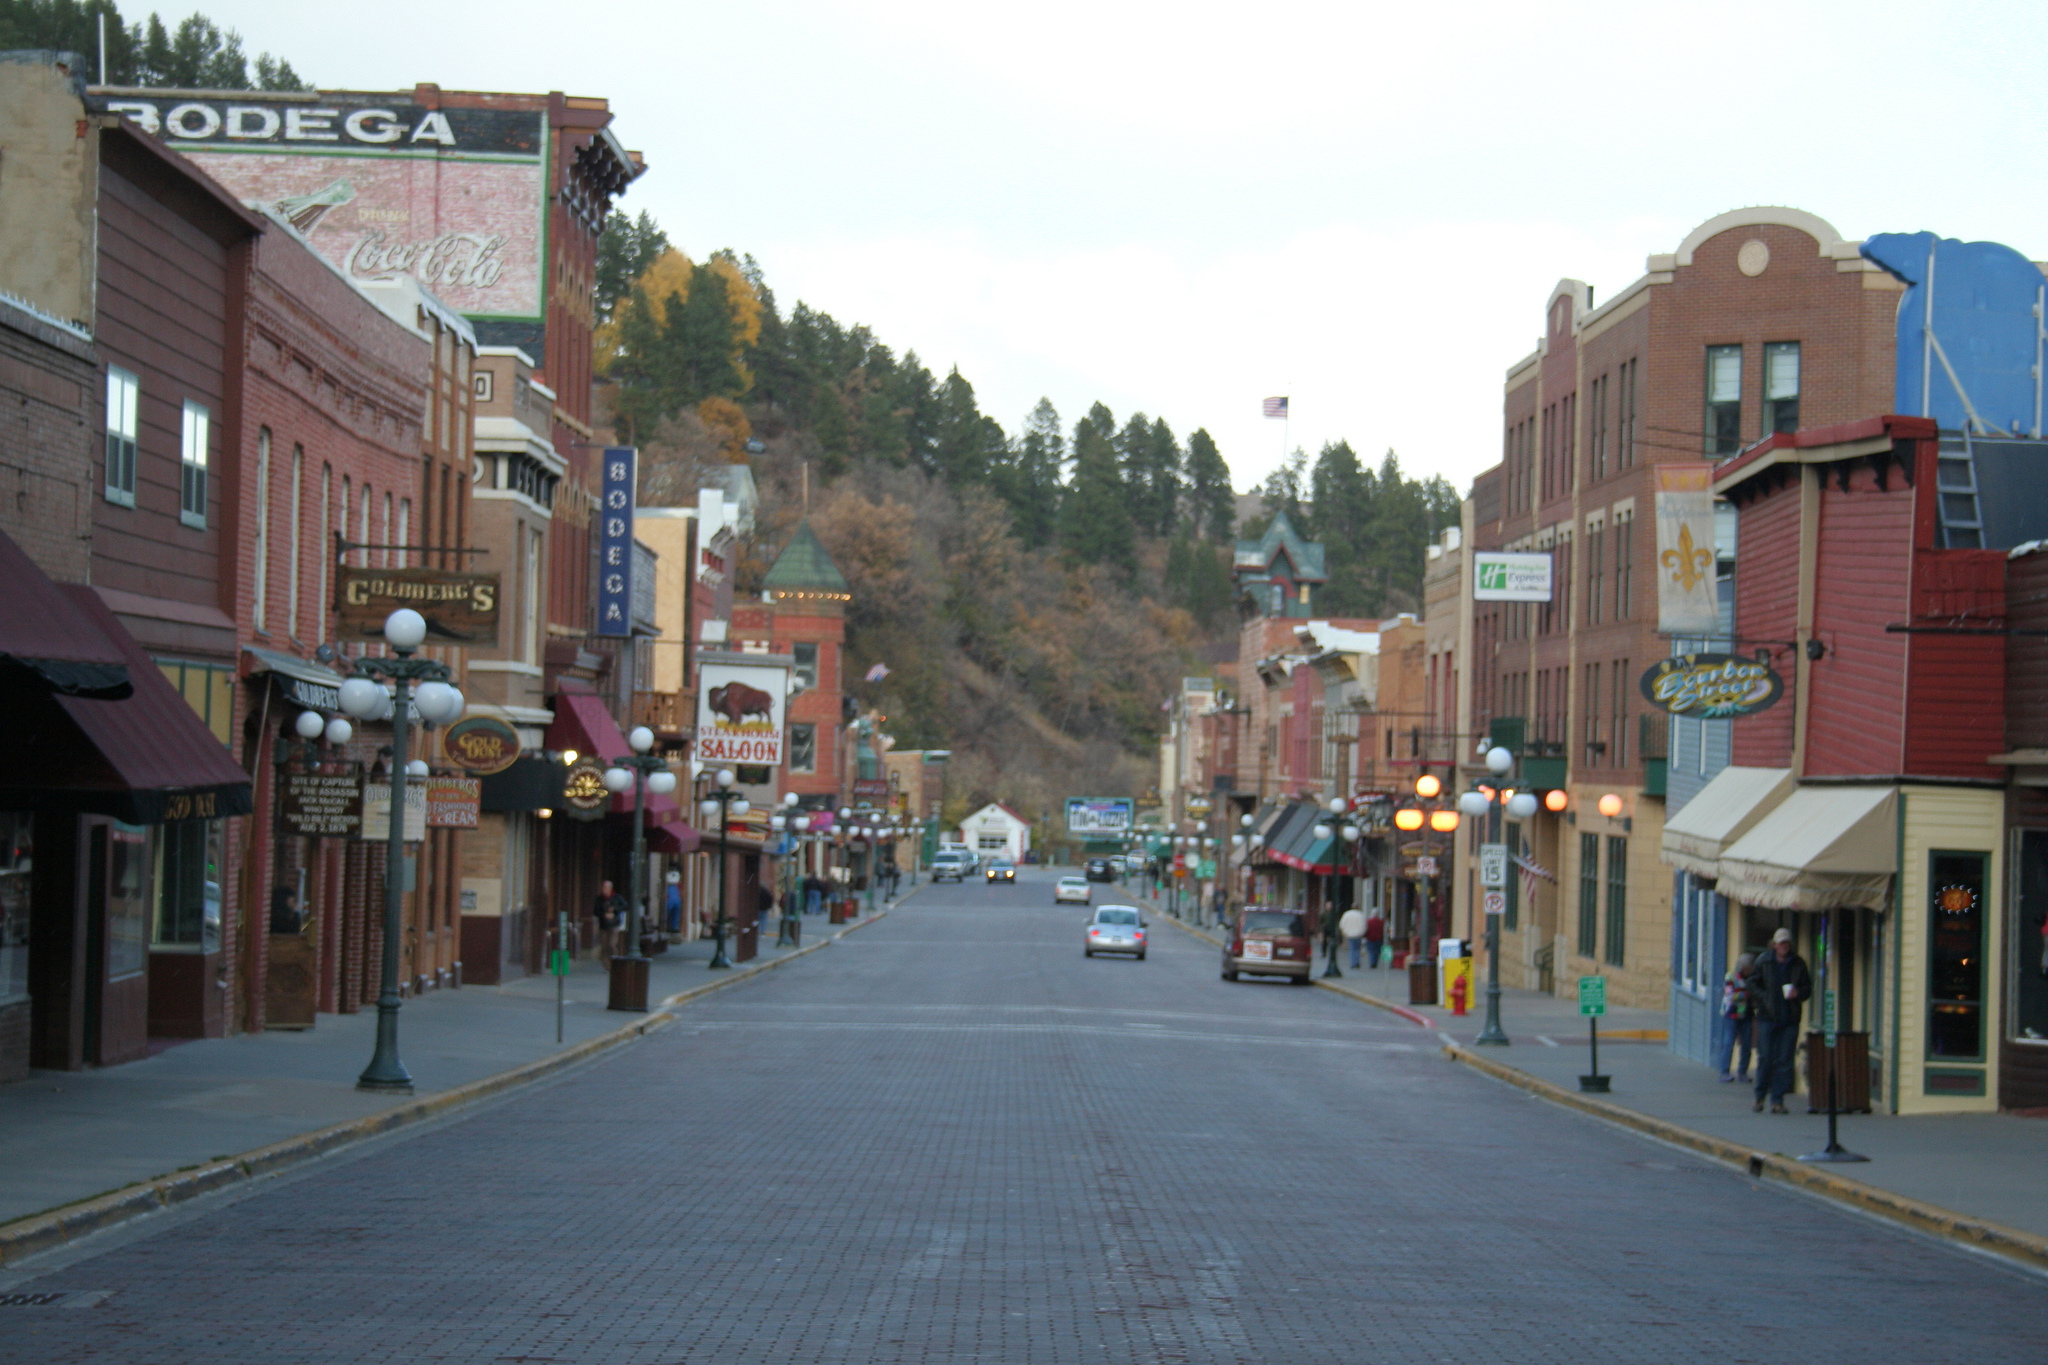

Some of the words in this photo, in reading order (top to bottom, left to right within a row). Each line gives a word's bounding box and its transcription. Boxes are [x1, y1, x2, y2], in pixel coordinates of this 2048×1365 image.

[108, 102, 456, 146] BODEGA
[606, 461, 627, 623] BODEGA
[1508, 573, 1546, 583] Express
[347, 579, 494, 611] GOLDBERG'S
[1656, 660, 1764, 699] Bourbon
[1670, 679, 1757, 711] Street
[458, 733, 502, 749] GOLD
[701, 738, 779, 761] SALOON
[1485, 867, 1500, 881] 15
